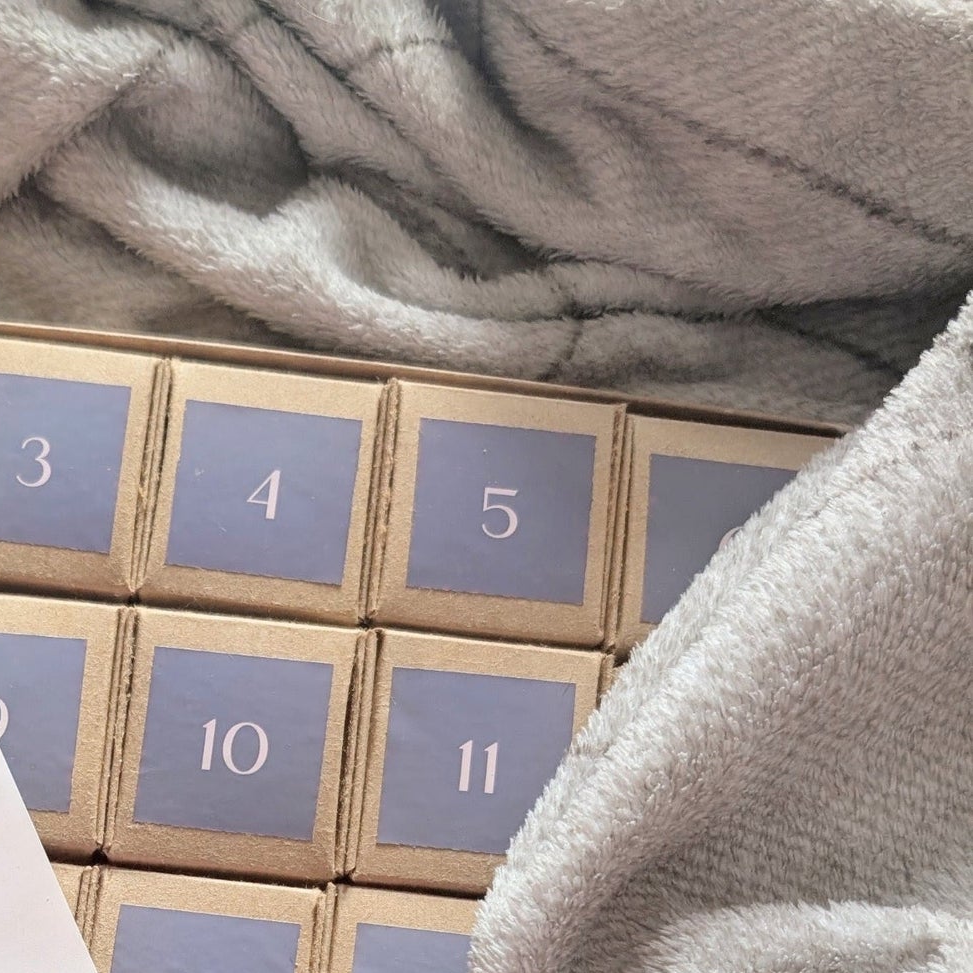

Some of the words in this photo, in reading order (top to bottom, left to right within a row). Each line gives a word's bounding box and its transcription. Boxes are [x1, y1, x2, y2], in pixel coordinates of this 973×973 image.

[16, 437, 52, 488] 3
[246, 469, 281, 520] 4
[481, 487, 519, 539] 5
[200, 718, 269, 776] 10
[457, 739, 498, 795] 11
